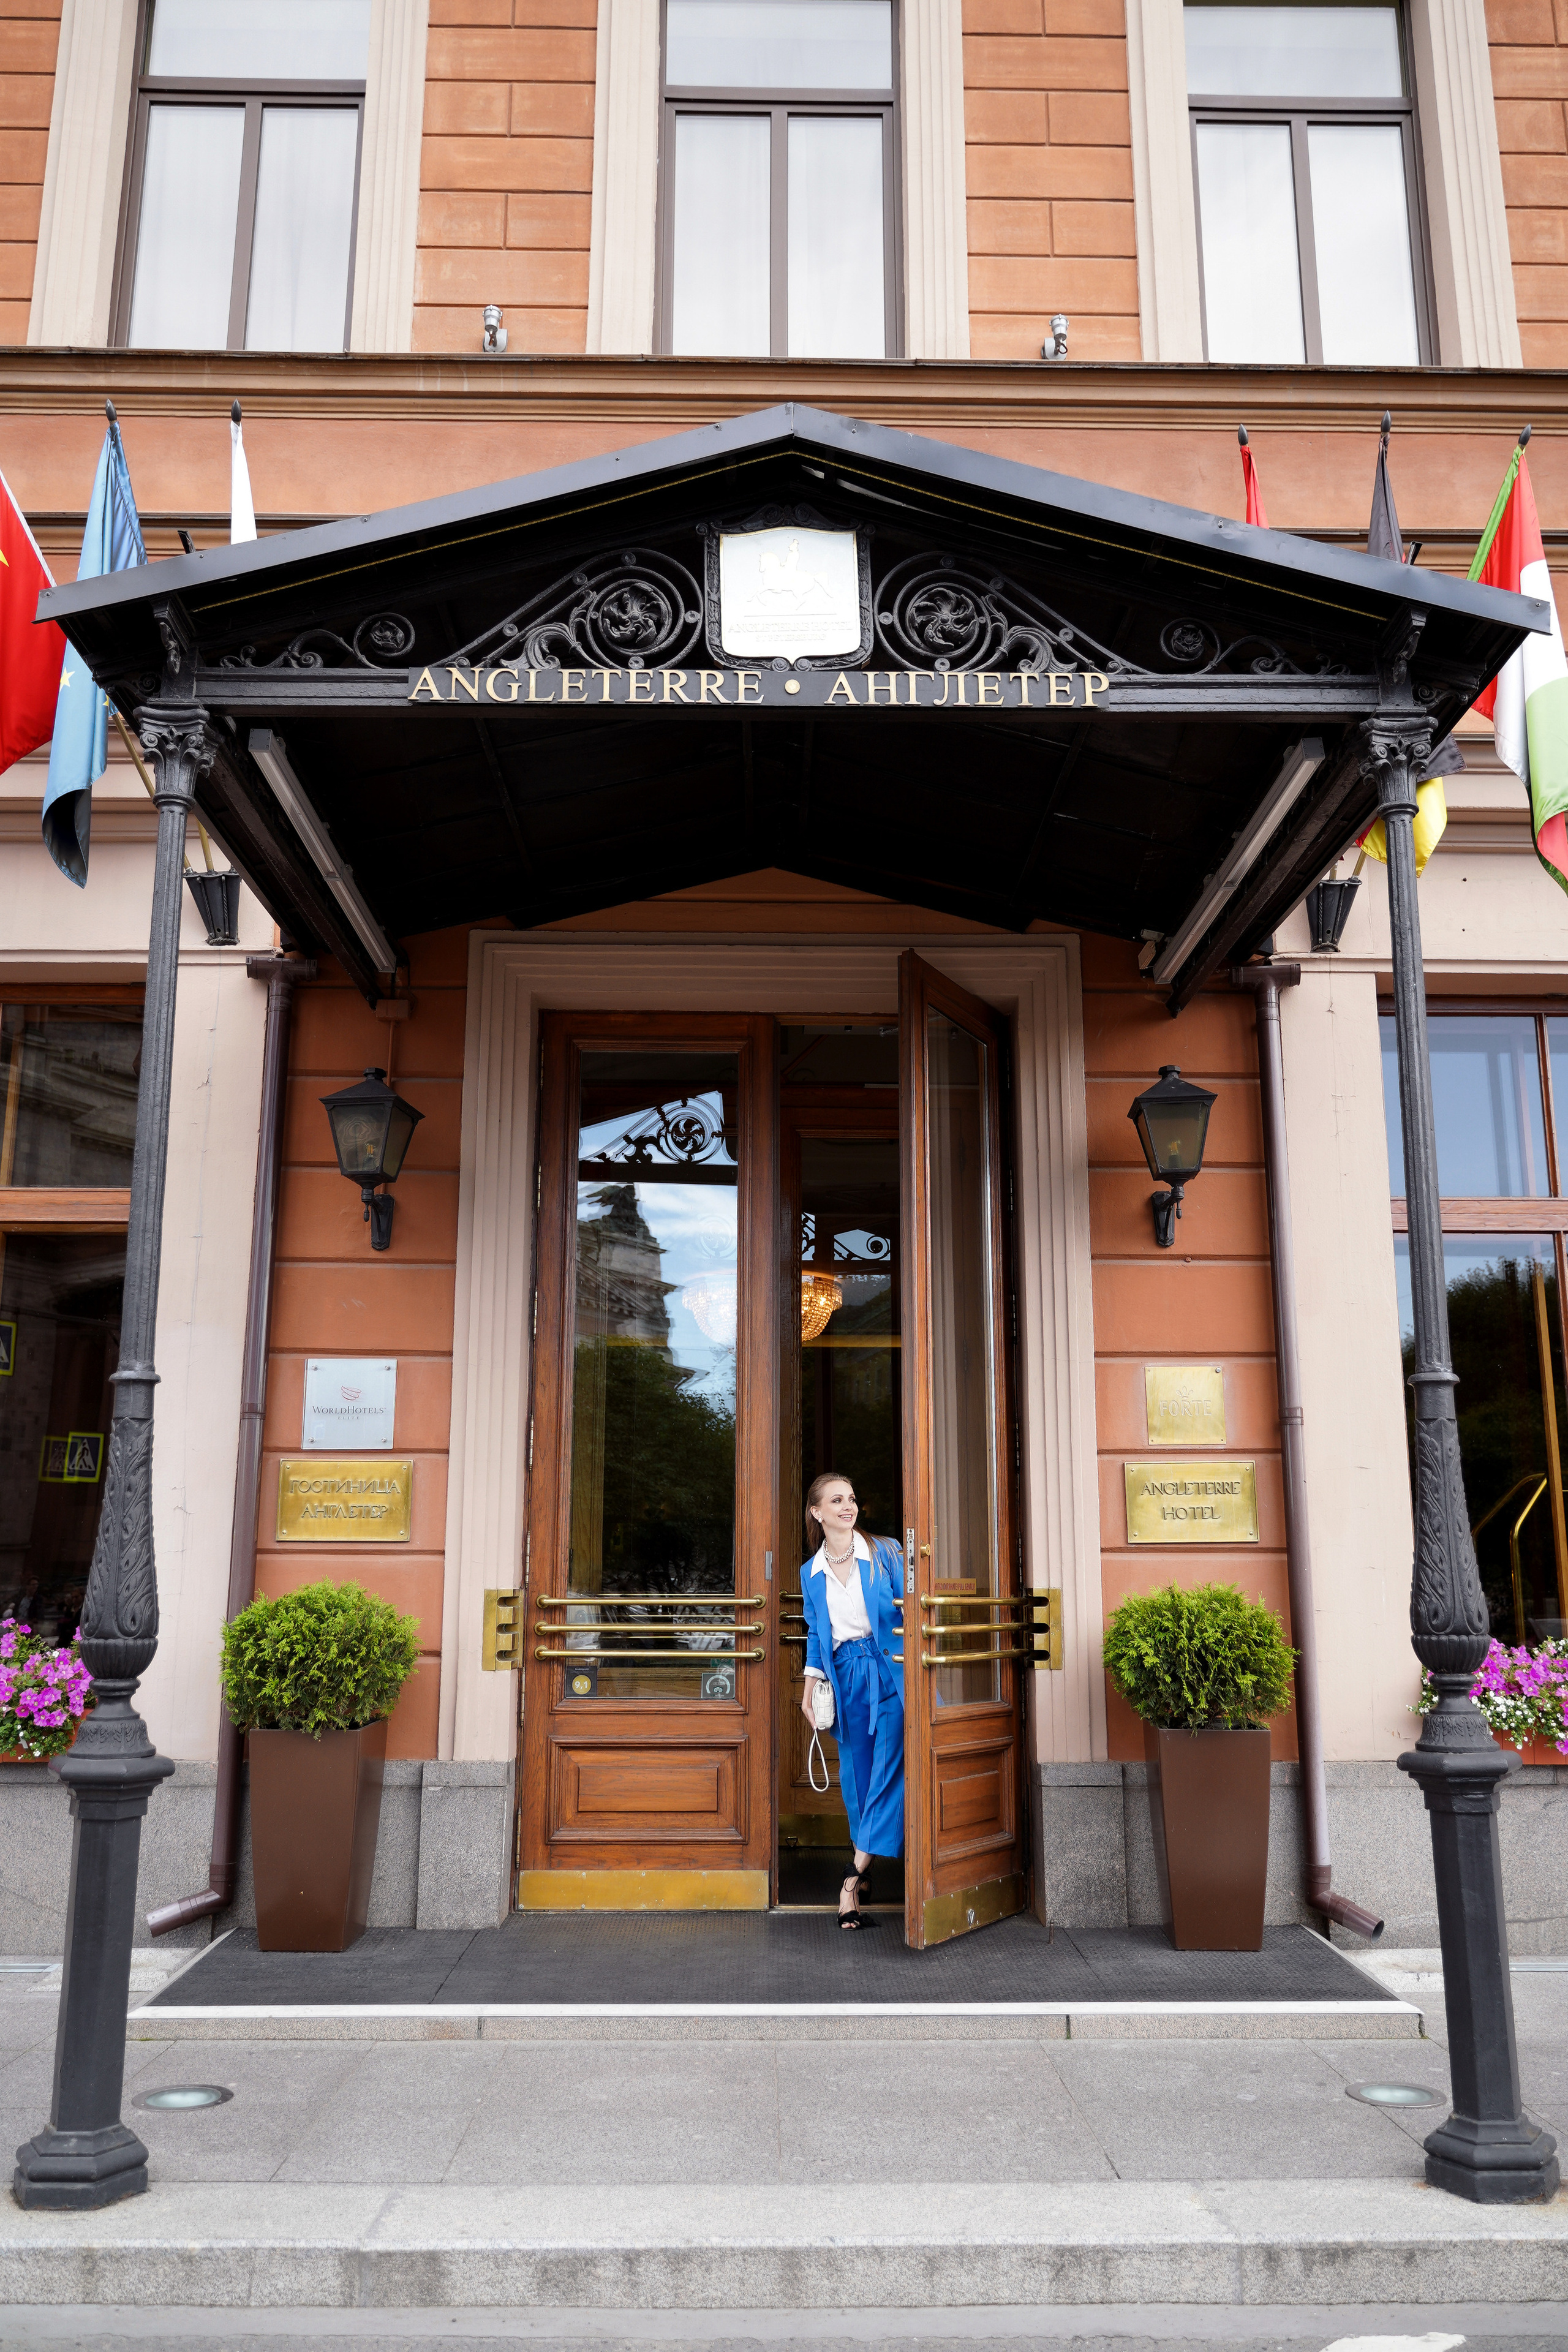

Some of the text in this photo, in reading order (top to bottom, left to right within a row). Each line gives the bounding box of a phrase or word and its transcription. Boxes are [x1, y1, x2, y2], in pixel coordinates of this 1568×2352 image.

[729, 622, 853, 632] ANGLETERRE HOTEL
[407, 667, 764, 704] ANGLETERRE
[824, 671, 1109, 707] АНГЛЕТЕР
[1159, 1400, 1212, 1417] FORTE
[290, 1480, 400, 1494] ГОСТИНИЦА
[1141, 1482, 1240, 1496] ANGLETERRE
[301, 1504, 388, 1518] АНГЛЕТЕР
[1163, 1507, 1221, 1520] HOTEL
[575, 1681, 588, 1689] 9,1
